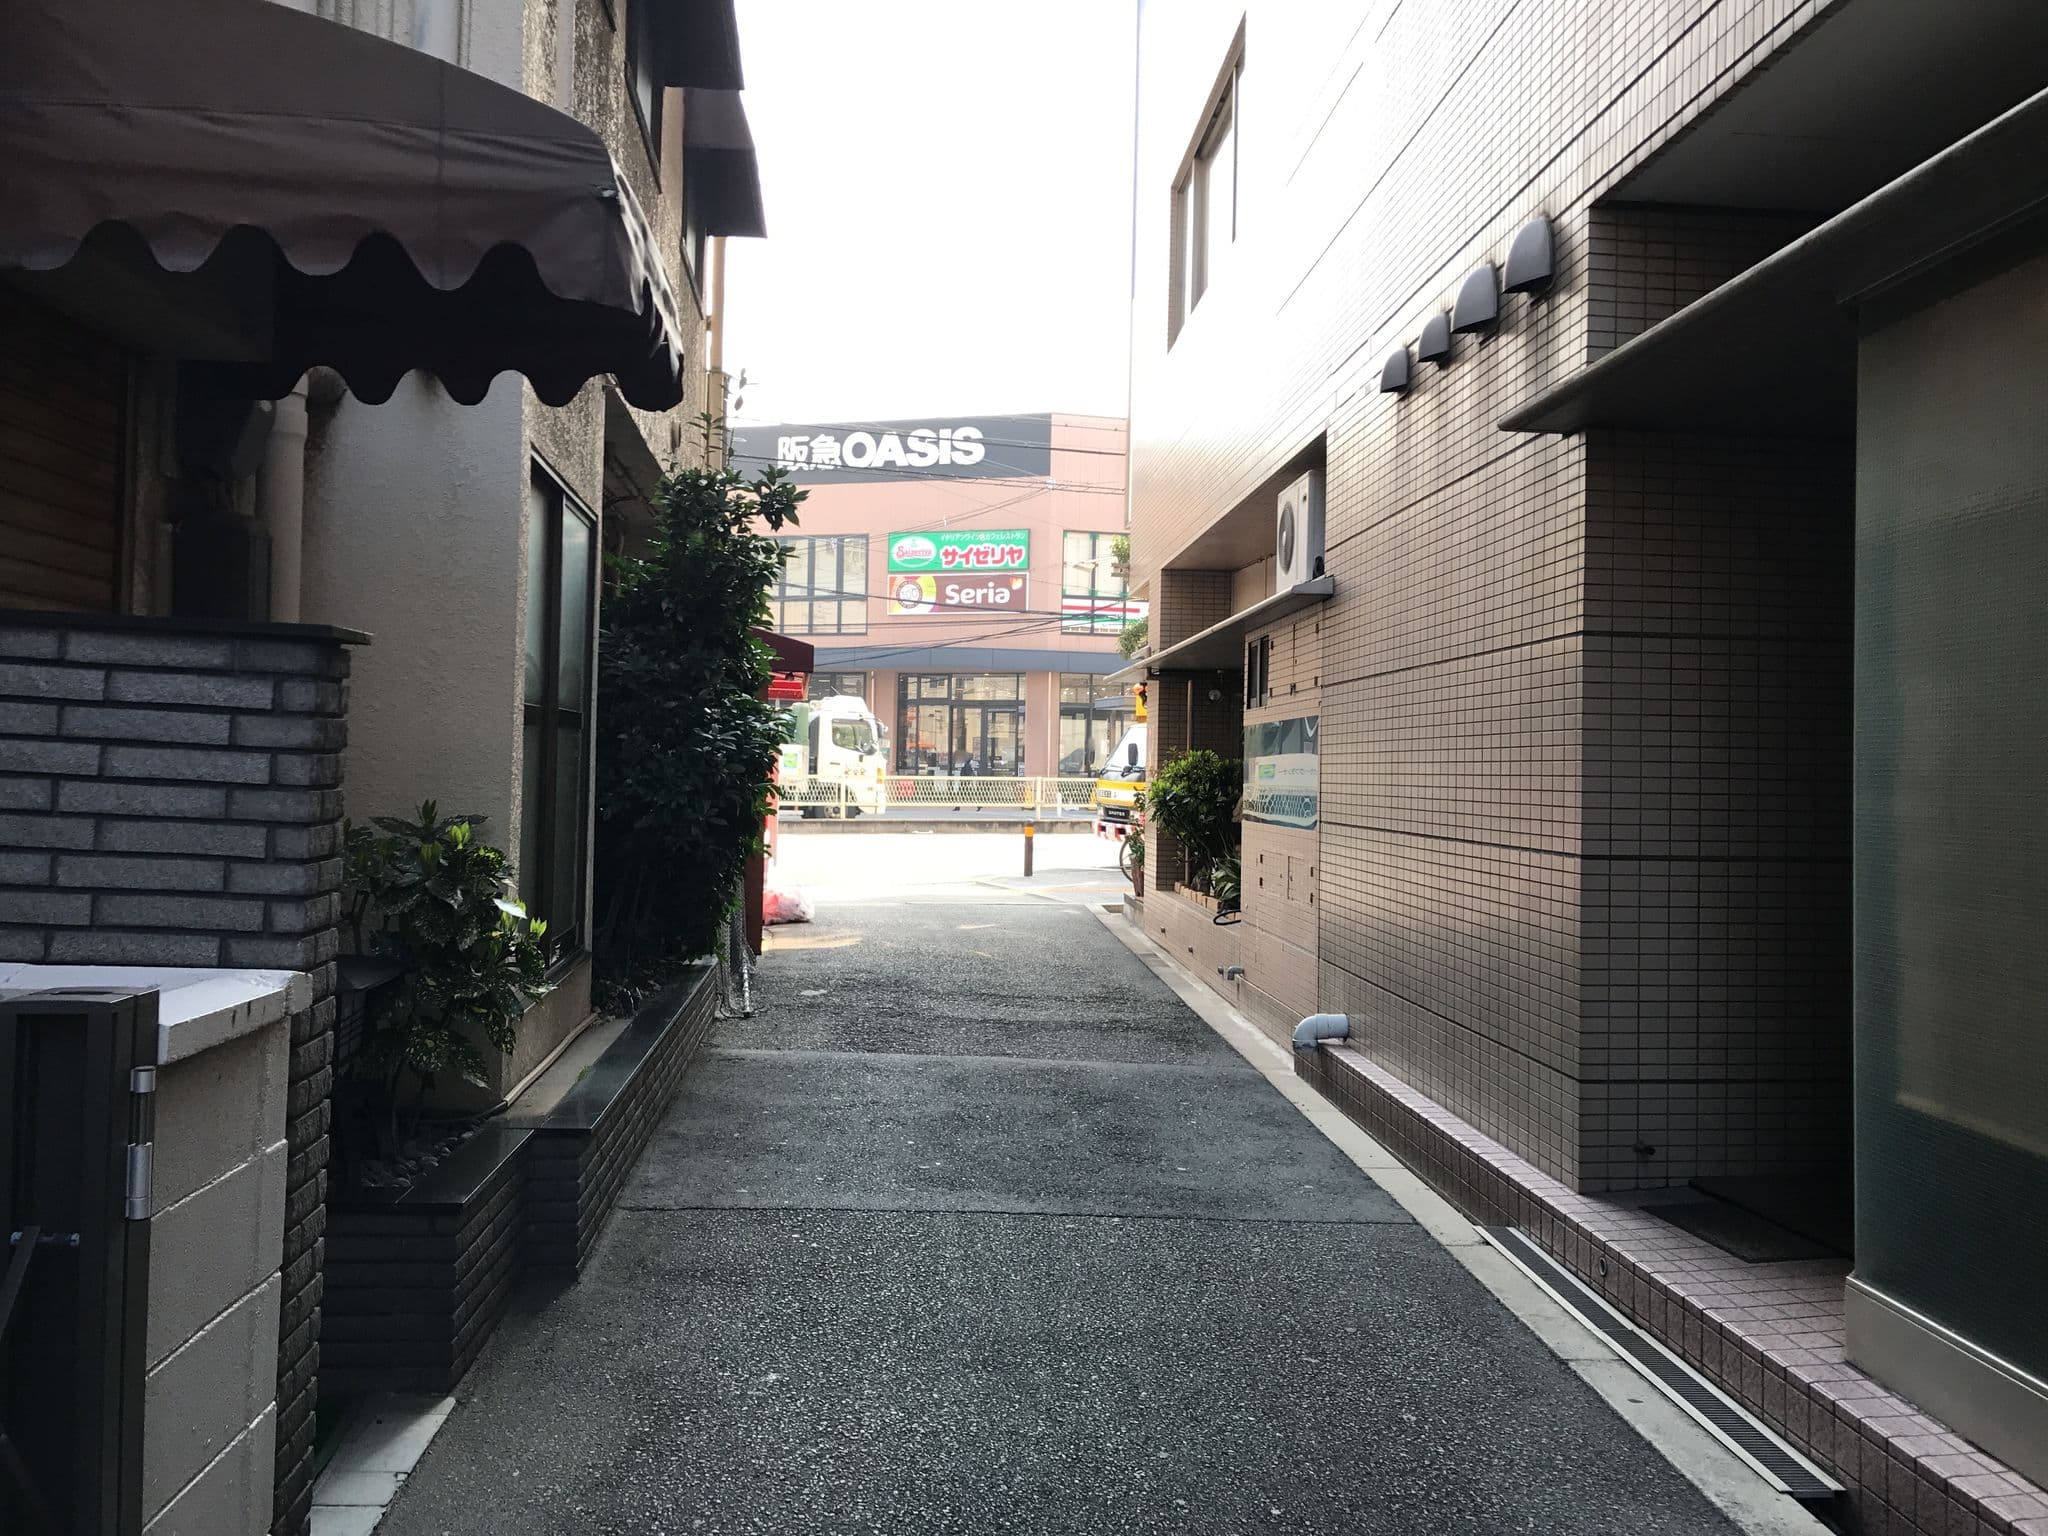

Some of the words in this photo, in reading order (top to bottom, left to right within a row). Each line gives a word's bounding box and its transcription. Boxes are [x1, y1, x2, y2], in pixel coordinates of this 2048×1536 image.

[778, 427, 985, 471] 阪急OASIS
[941, 545, 1024, 567] サイゼリヤ
[945, 581, 1011, 604] Seria
